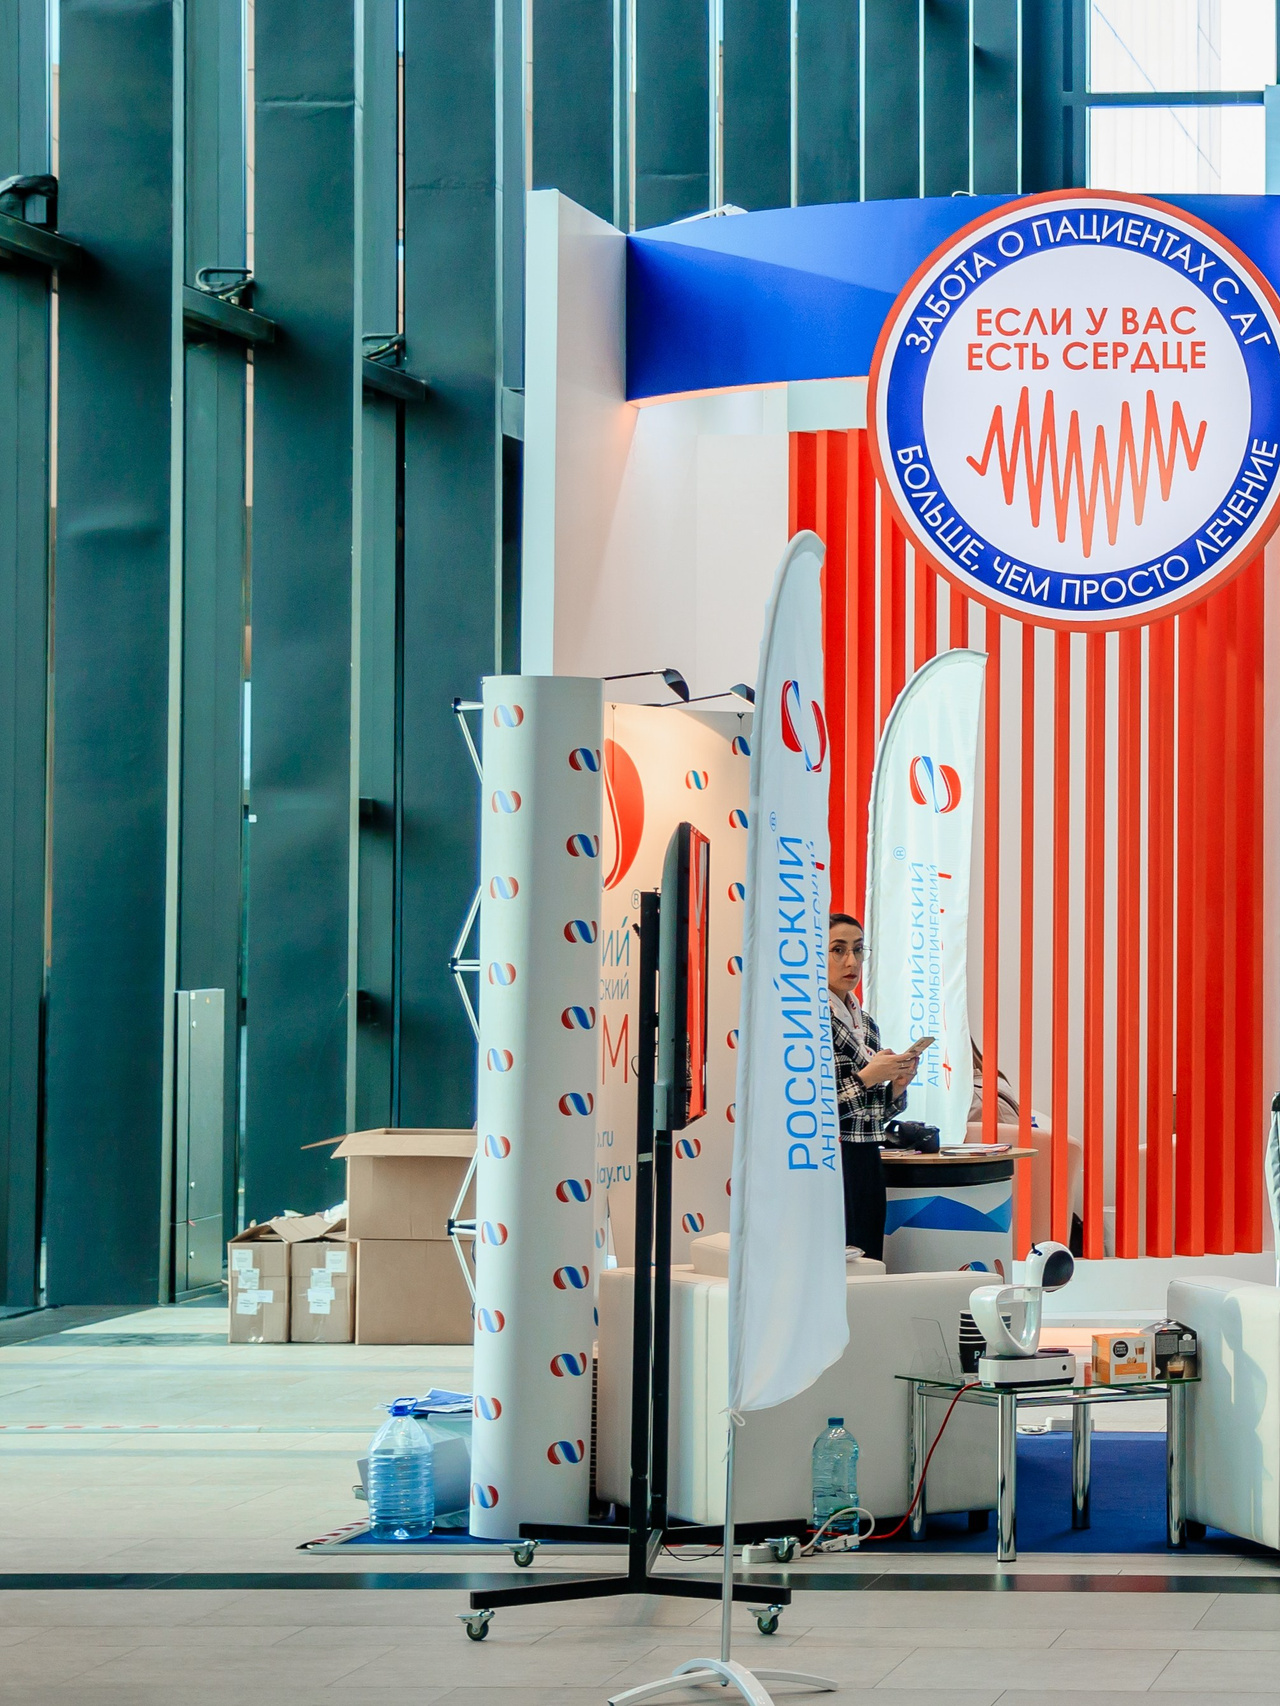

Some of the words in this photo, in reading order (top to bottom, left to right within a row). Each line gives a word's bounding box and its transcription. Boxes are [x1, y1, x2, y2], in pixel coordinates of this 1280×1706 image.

[905, 252, 997, 354] ЗАБОТА
[998, 231, 1024, 258] О
[1032, 214, 1216, 282] ПАЦИЕНТАХ
[1213, 277, 1240, 304] С
[1230, 313, 1271, 349] АГ
[976, 308, 1072, 336] ЕСЛИ
[1085, 307, 1108, 336] У
[1121, 306, 1197, 335] ВАС
[967, 342, 1050, 371] ЕСТЬ
[1062, 341, 1207, 373] СЕРДЦЕ
[897, 445, 984, 572] БОЛЬШЕ,
[993, 555, 1050, 601] ЧЕМ
[1061, 555, 1190, 605] ПРОСТО
[1195, 439, 1279, 565] ЛЕЧЕНИЕ
[772, 836, 820, 1170] РОССИЙСКИЙ
